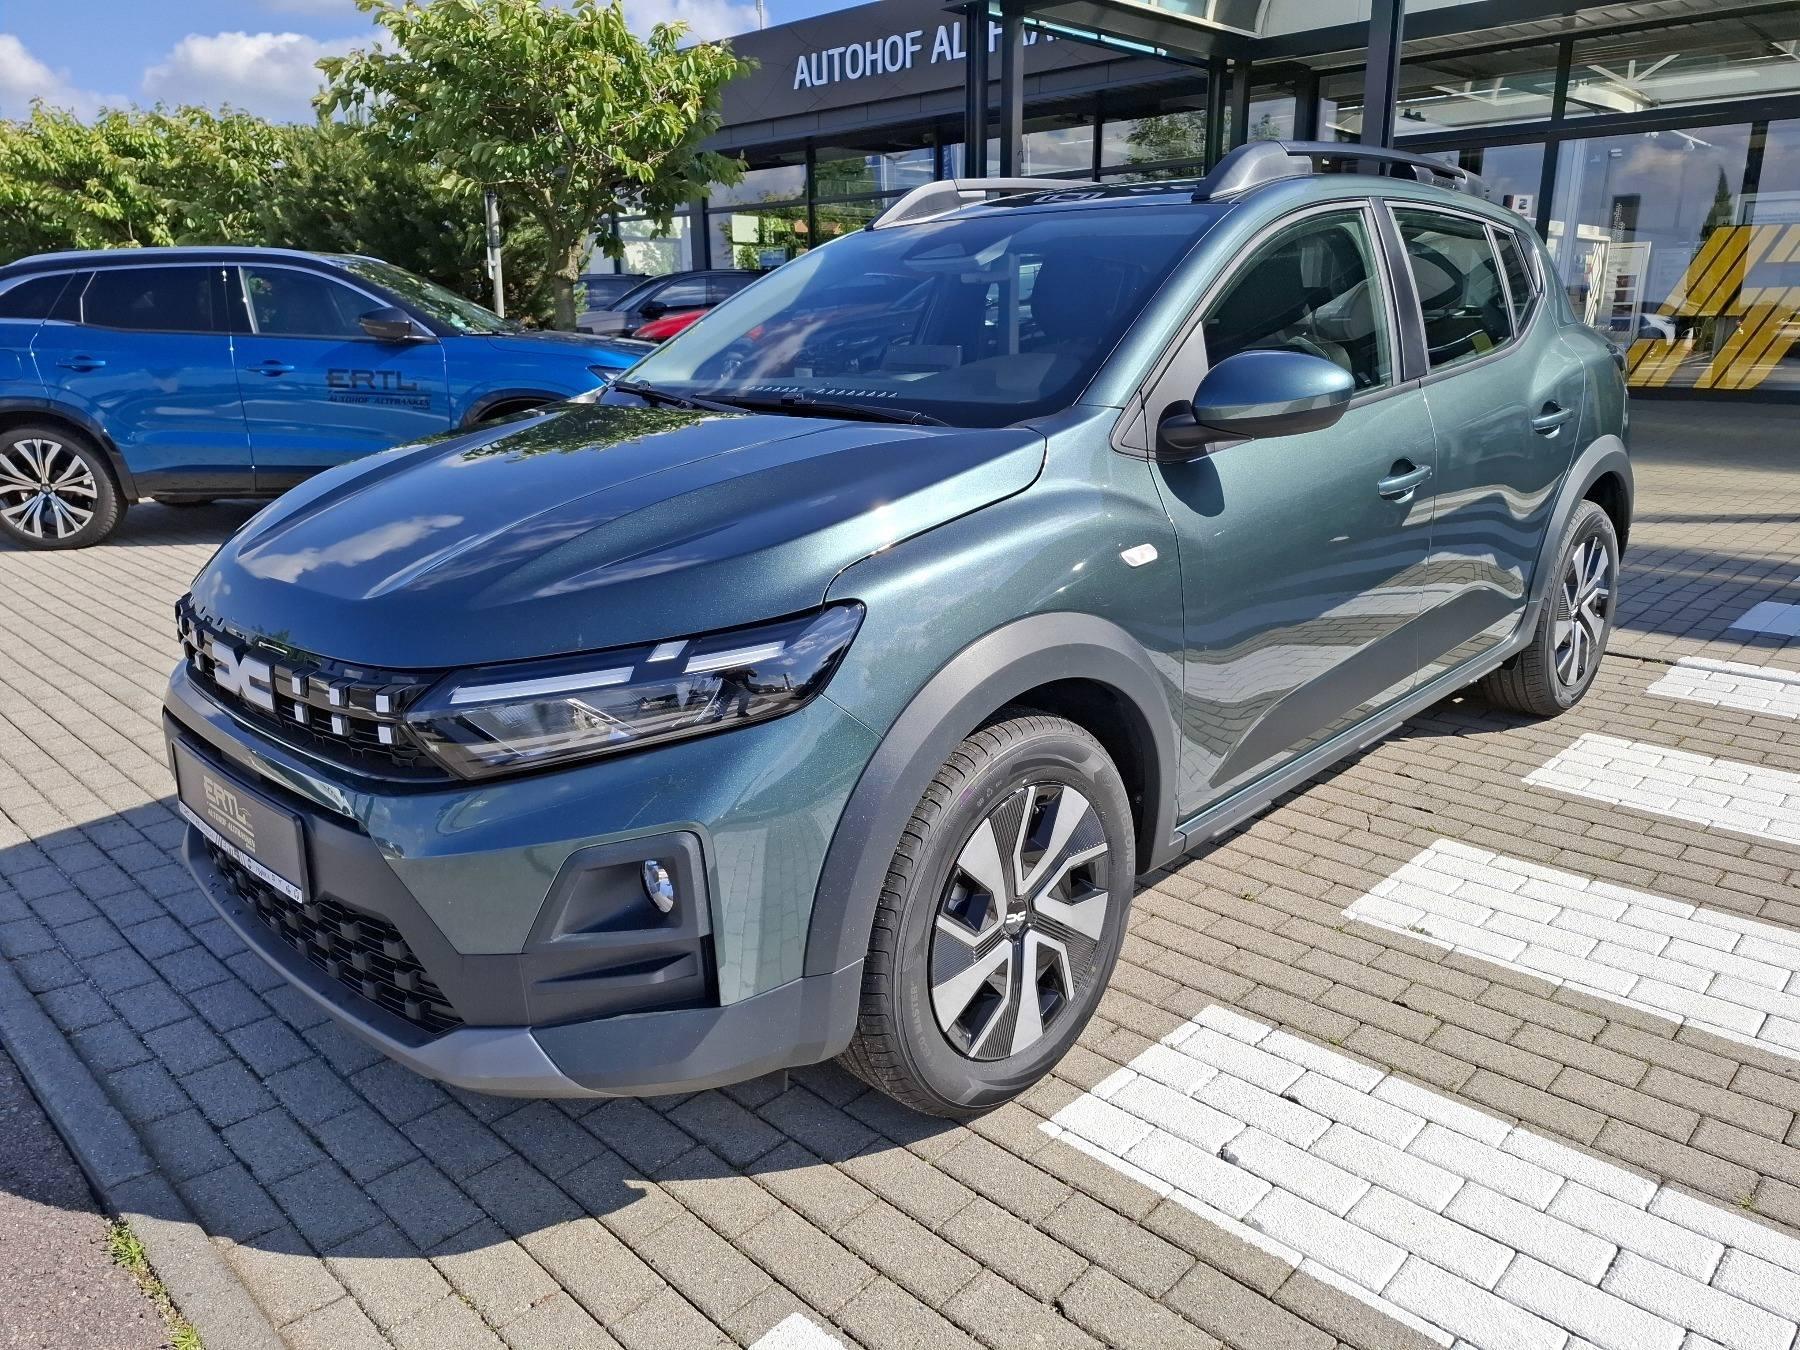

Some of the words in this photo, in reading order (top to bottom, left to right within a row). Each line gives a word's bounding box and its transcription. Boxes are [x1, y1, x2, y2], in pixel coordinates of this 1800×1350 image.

[793, 30, 923, 90] AUTOHOF
[328, 368, 418, 391] ERTL
[204, 775, 247, 826] ERTL
